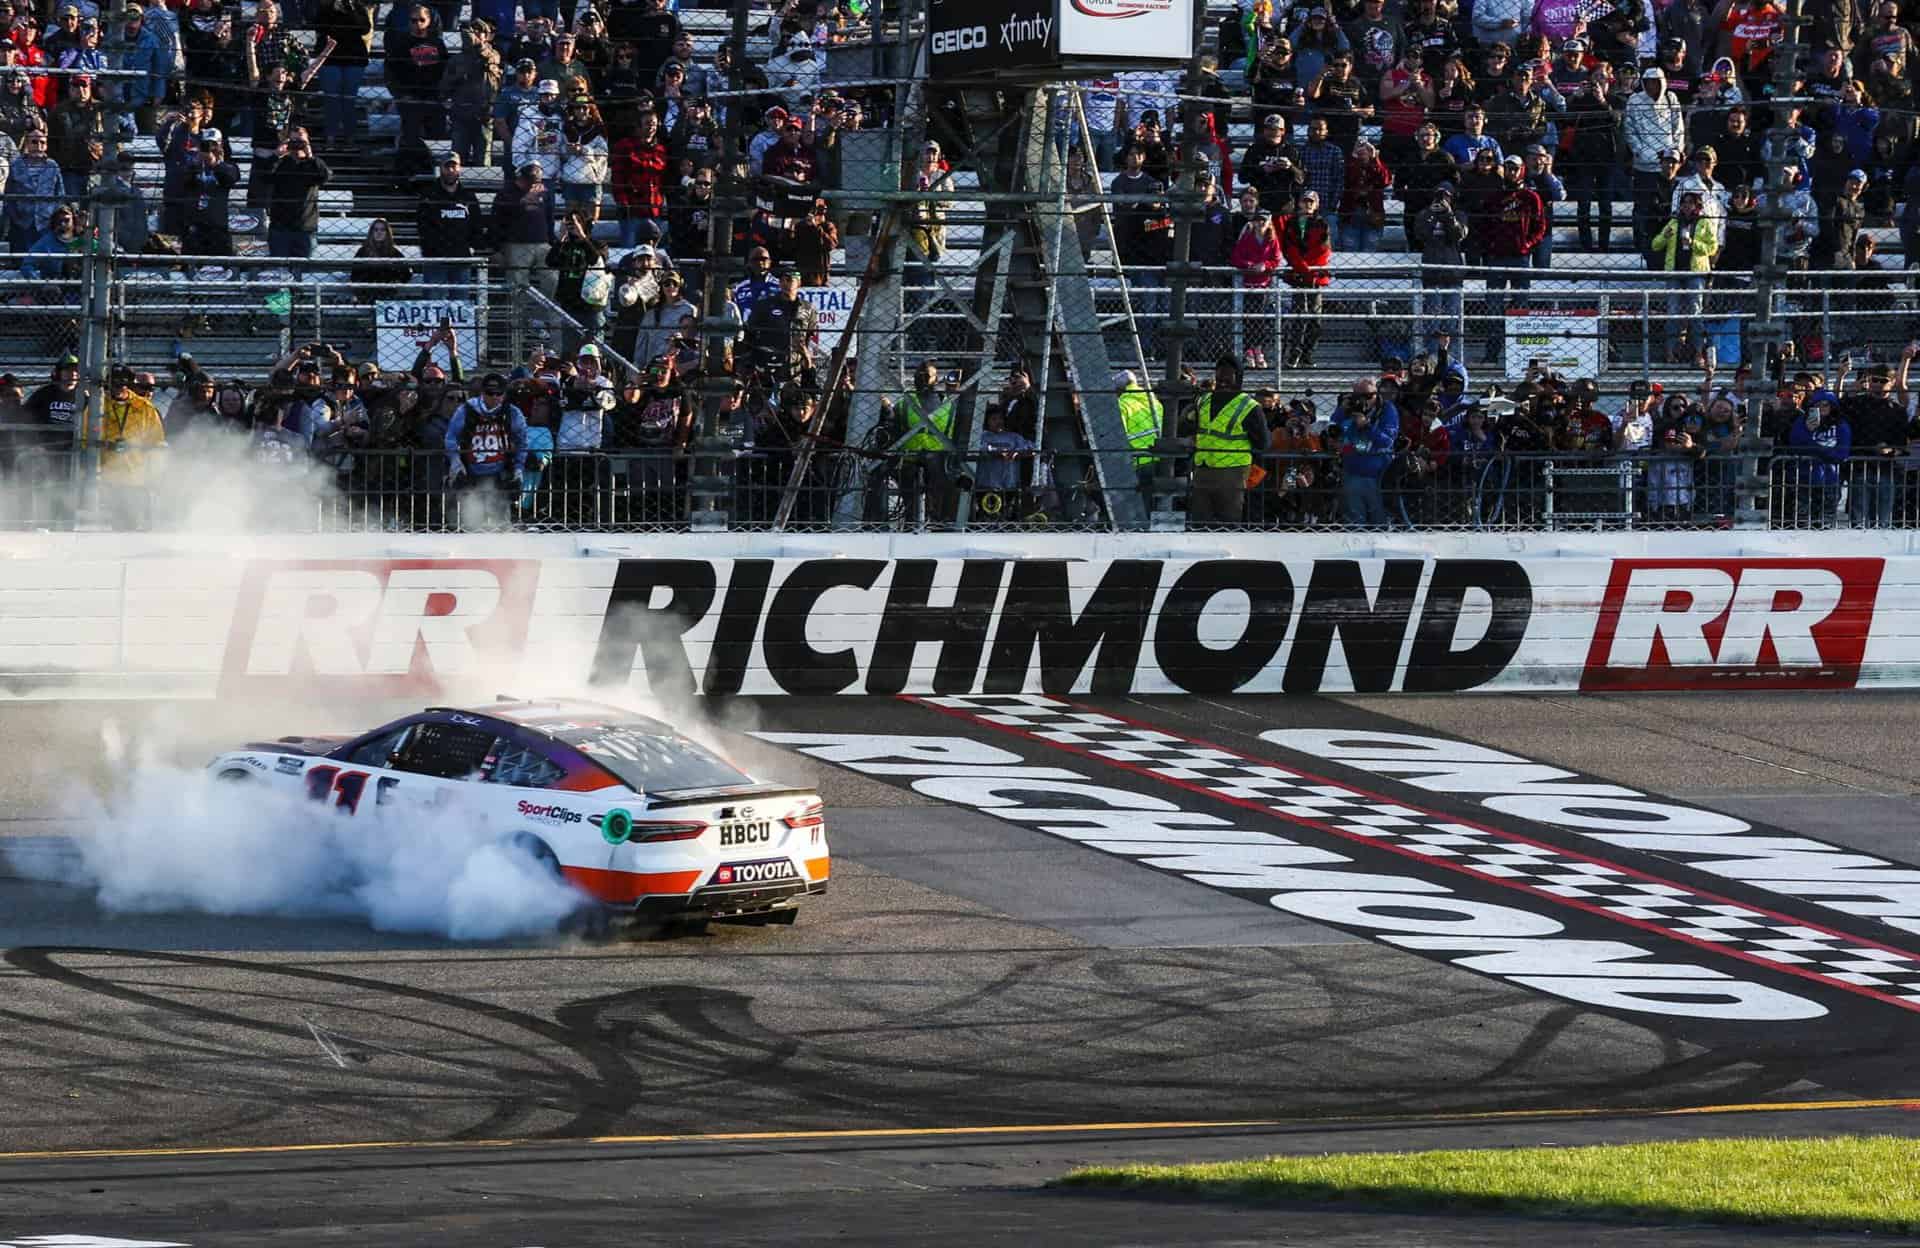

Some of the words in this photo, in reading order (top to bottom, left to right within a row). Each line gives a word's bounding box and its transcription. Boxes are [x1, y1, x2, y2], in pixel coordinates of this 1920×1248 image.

[932, 26, 987, 54] GEICO
[1000, 12, 1053, 52] xfinity
[384, 306, 468, 324] CAPITAL
[245, 568, 503, 675] RR
[587, 558, 1533, 698] RICHMOND
[1607, 568, 1844, 667] RR
[305, 764, 372, 817] 11
[517, 799, 582, 823] SportClips
[719, 821, 771, 846] HBCU
[734, 861, 795, 882] TOYOTA
[748, 729, 1830, 1021] RICHMOND
